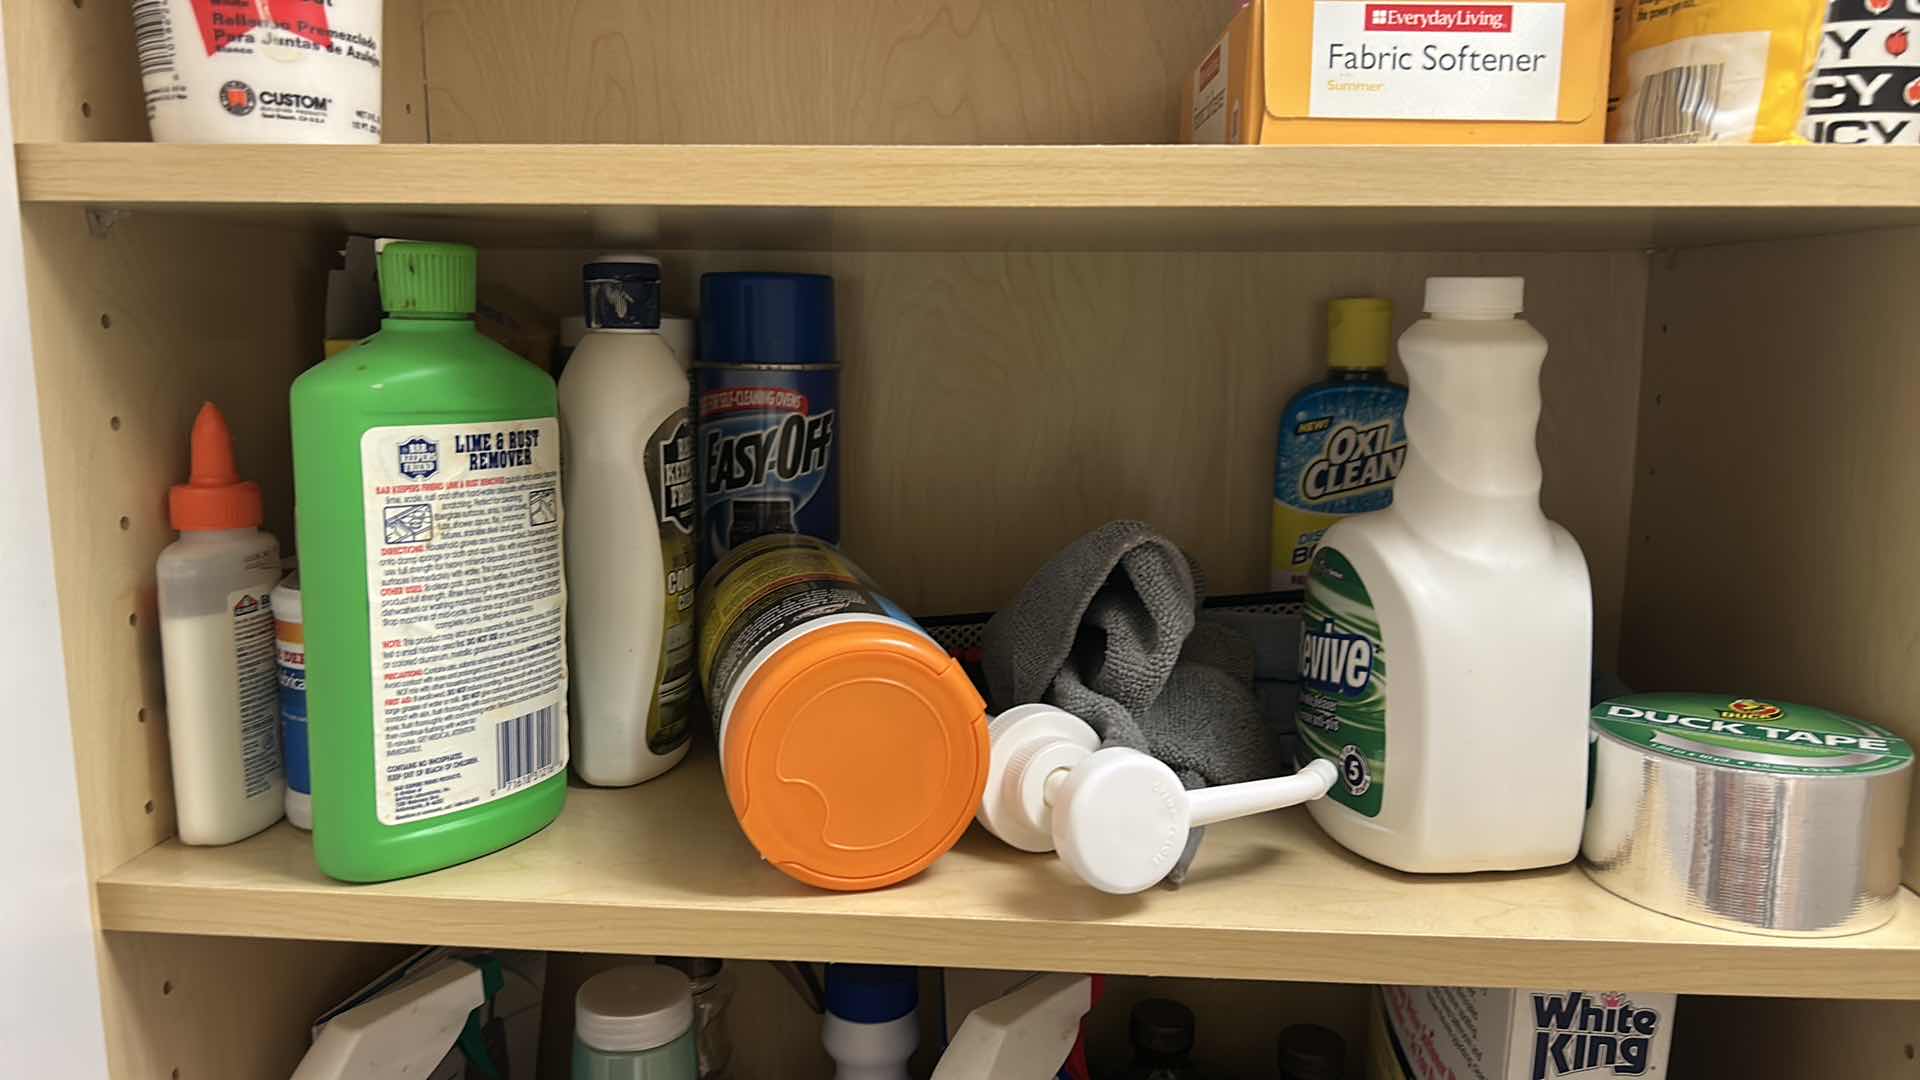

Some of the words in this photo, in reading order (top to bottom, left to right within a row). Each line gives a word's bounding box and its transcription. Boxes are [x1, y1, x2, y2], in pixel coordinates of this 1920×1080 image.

[214, 29, 255, 43] Para
[261, 32, 321, 51] Juntas
[326, 42, 343, 54] de
[1328, 43, 1412, 70] Fabric
[1423, 44, 1546, 73] Softener
[260, 91, 327, 111] CUSTOM
[1328, 80, 1385, 92] Summer
[455, 432, 491, 453] LIME
[496, 432, 503, 448] &
[509, 429, 539, 448] RUST
[469, 449, 532, 471] REMOVER
[706, 411, 834, 494] EASY-OFF
[1329, 425, 1389, 464] OXI
[1305, 445, 1407, 498] CLEAN
[1303, 622, 1371, 688] evive
[1608, 705, 1744, 734] DUCK
[1756, 726, 1890, 751] TAPE
[1532, 991, 1657, 1035] White
[1532, 1031, 1650, 1080] King
